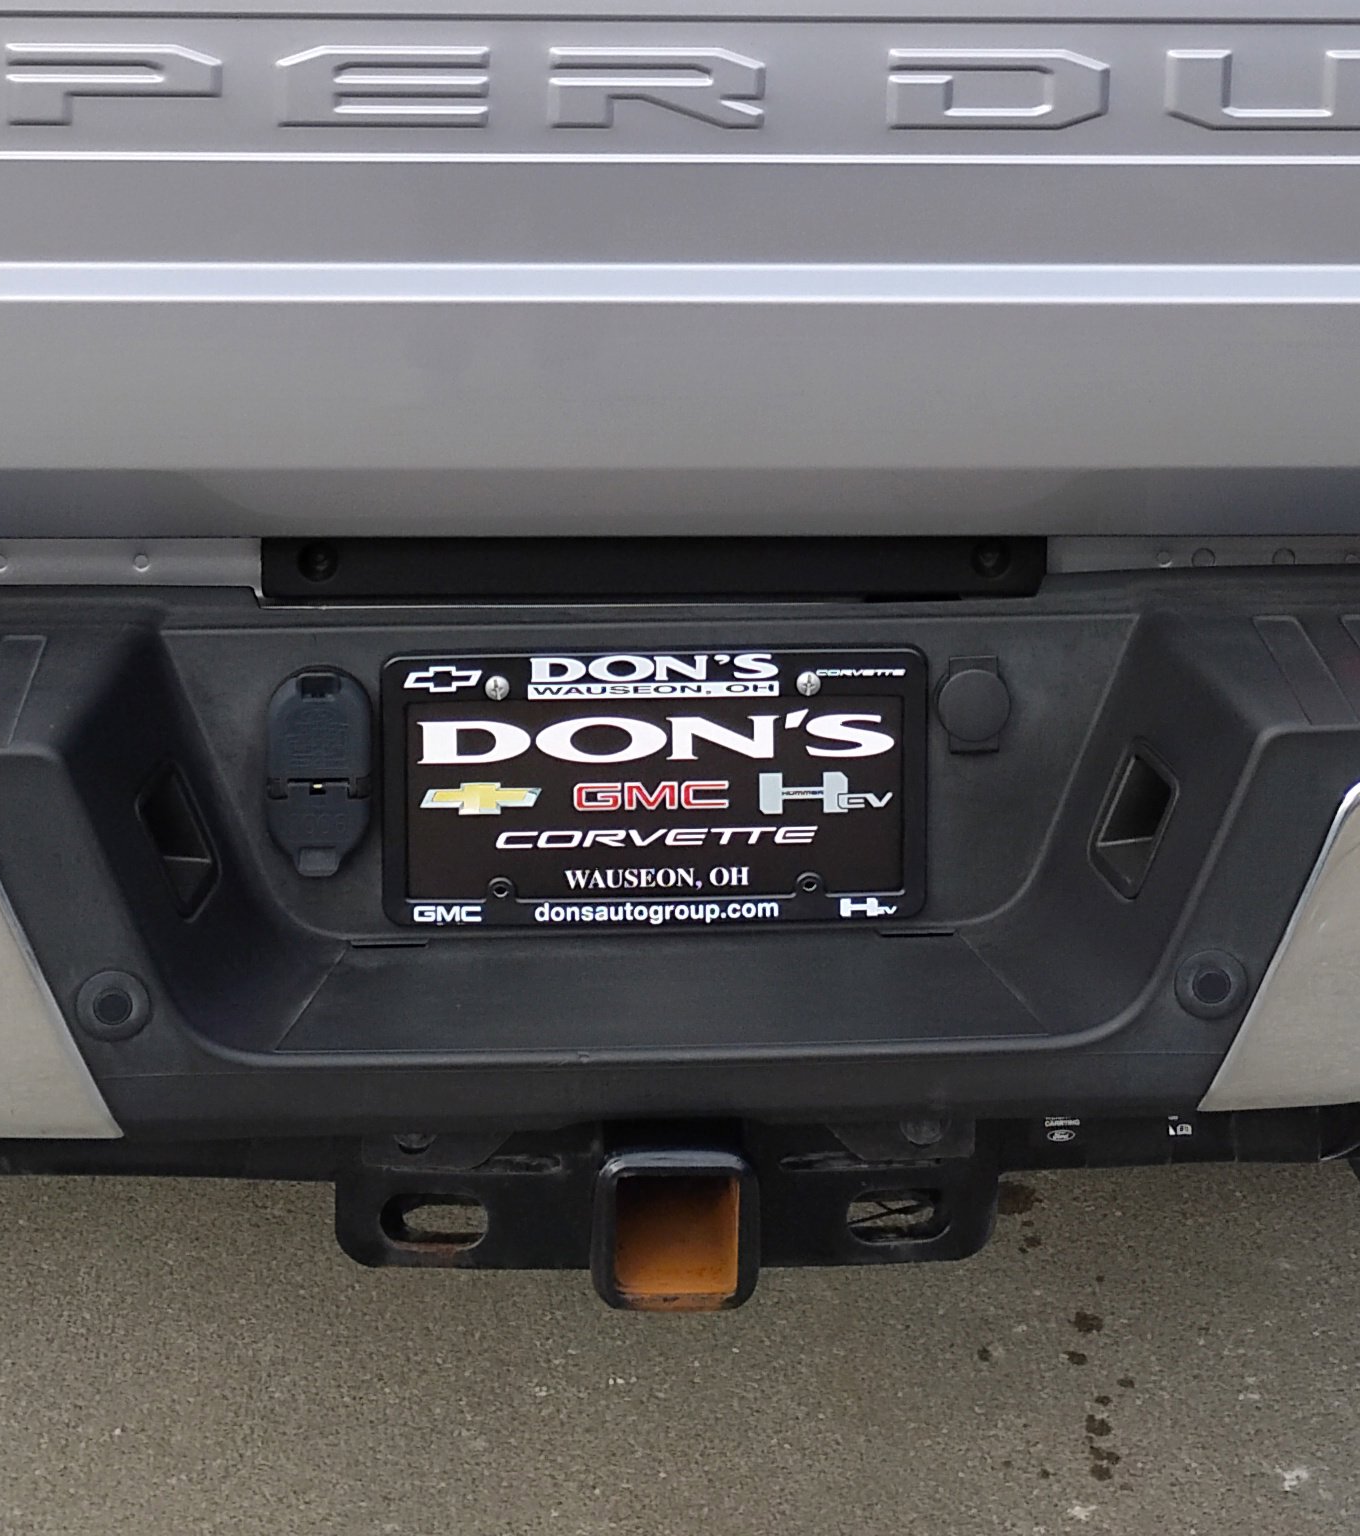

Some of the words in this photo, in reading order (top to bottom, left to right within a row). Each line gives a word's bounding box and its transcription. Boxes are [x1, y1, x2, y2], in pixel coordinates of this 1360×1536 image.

[530, 654, 779, 682] DON'S
[816, 669, 906, 677] CORVETTE
[534, 684, 712, 696] WAUSEON,
[726, 683, 775, 693] OH
[417, 709, 895, 764] DON'S
[573, 780, 729, 812] GMC
[496, 826, 818, 849] CORVETTE
[564, 867, 702, 890] WAUSEON,
[710, 867, 749, 886] OH
[413, 906, 482, 922] GMC
[535, 901, 779, 925] donsautogroup.com
